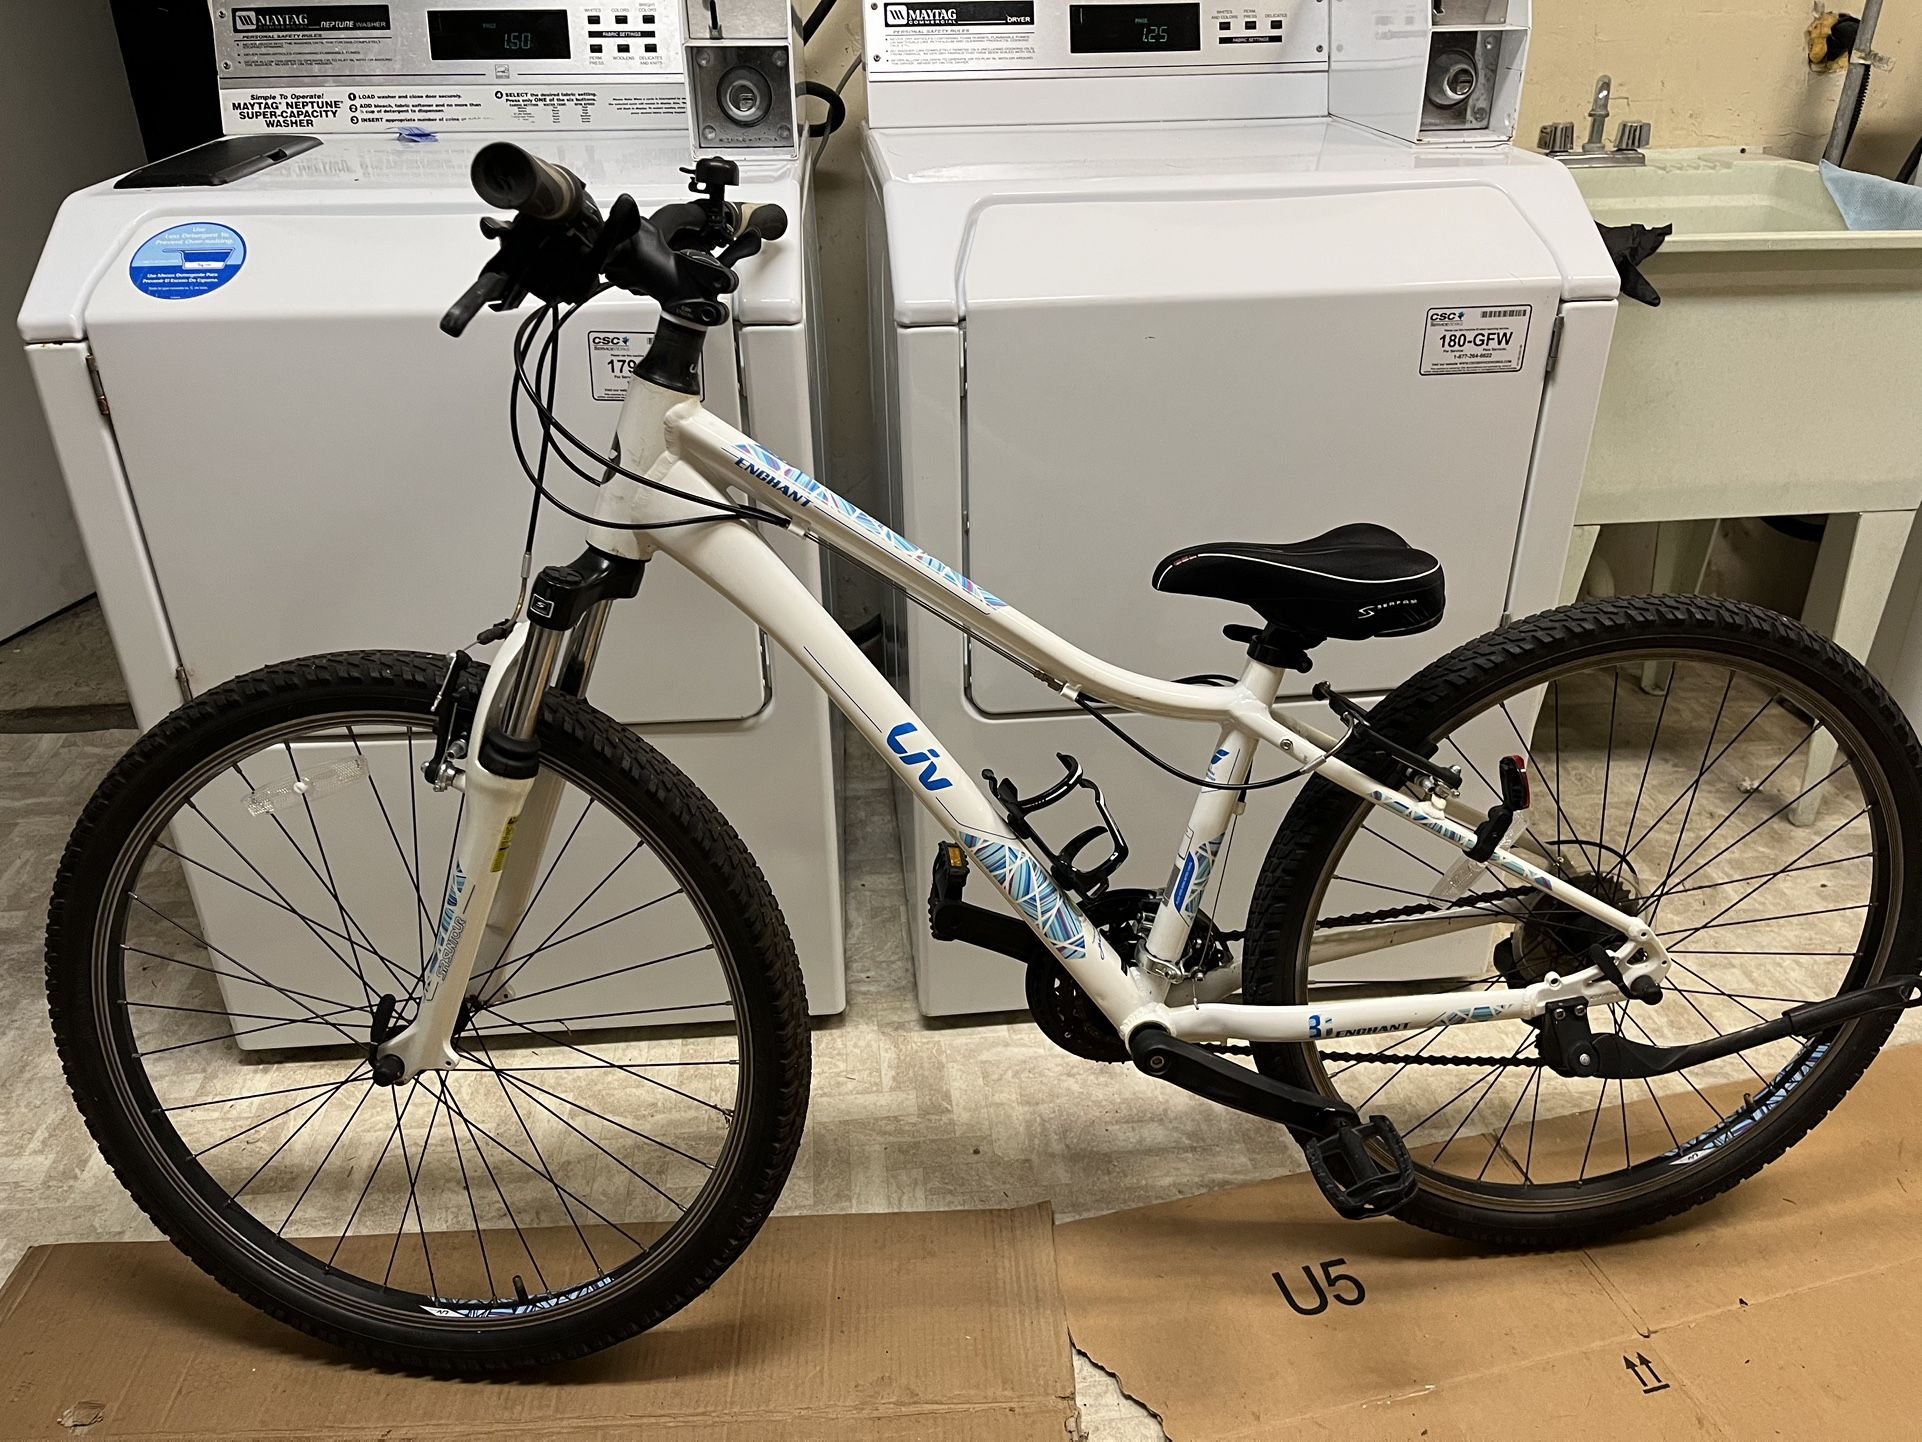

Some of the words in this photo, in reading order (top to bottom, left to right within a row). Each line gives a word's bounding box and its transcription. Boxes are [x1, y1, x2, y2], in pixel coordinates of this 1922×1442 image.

[258, 14, 308, 25] MAYTAG
[908, 9, 957, 20] MAYTAG
[504, 32, 531, 49] 1.50
[1142, 26, 1168, 42] 1.25
[290, 93, 324, 101] Operate!
[239, 110, 338, 120] SUPER-CAPACITY
[265, 119, 314, 128] WASHER
[592, 336, 620, 344] CSC
[1440, 332, 1514, 348] 180-GFW
[734, 457, 814, 508] ENCHANT
[886, 722, 954, 792] Liv
[441, 916, 467, 964] SUNTOUR
[1335, 1022, 1412, 1038] ENCHANT
[1272, 1258, 1366, 1316] U5
